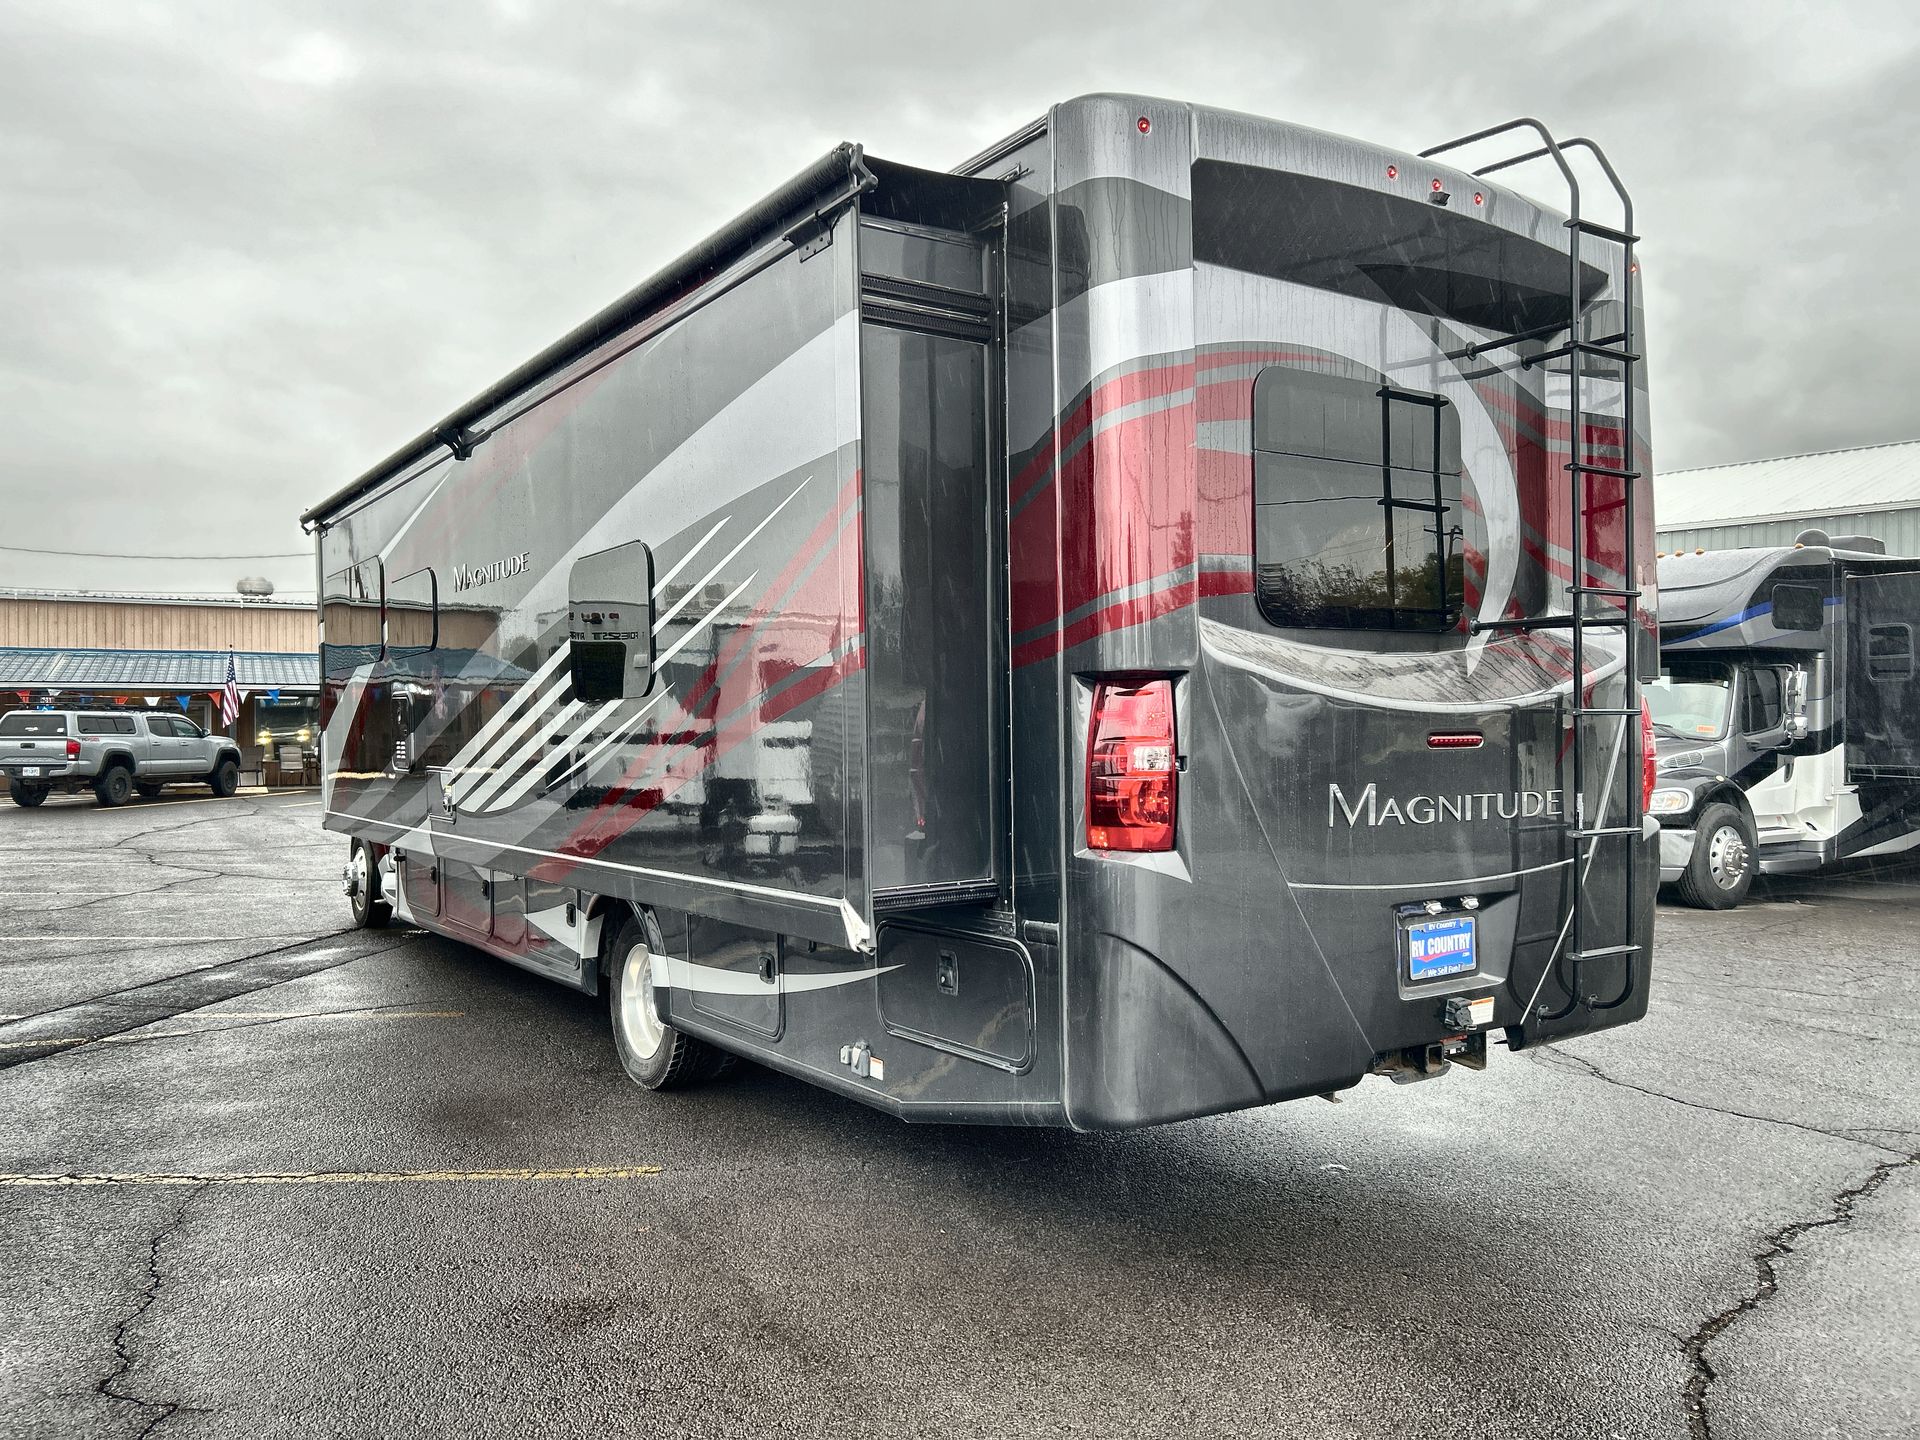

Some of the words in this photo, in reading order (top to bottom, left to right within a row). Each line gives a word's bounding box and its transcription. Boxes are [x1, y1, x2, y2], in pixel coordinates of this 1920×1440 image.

[453, 551, 530, 593] MAGNITUDE
[1328, 783, 1563, 828] MAGNITUDE
[1411, 939, 1425, 958] RV
[1427, 932, 1471, 955] COUNTRY
